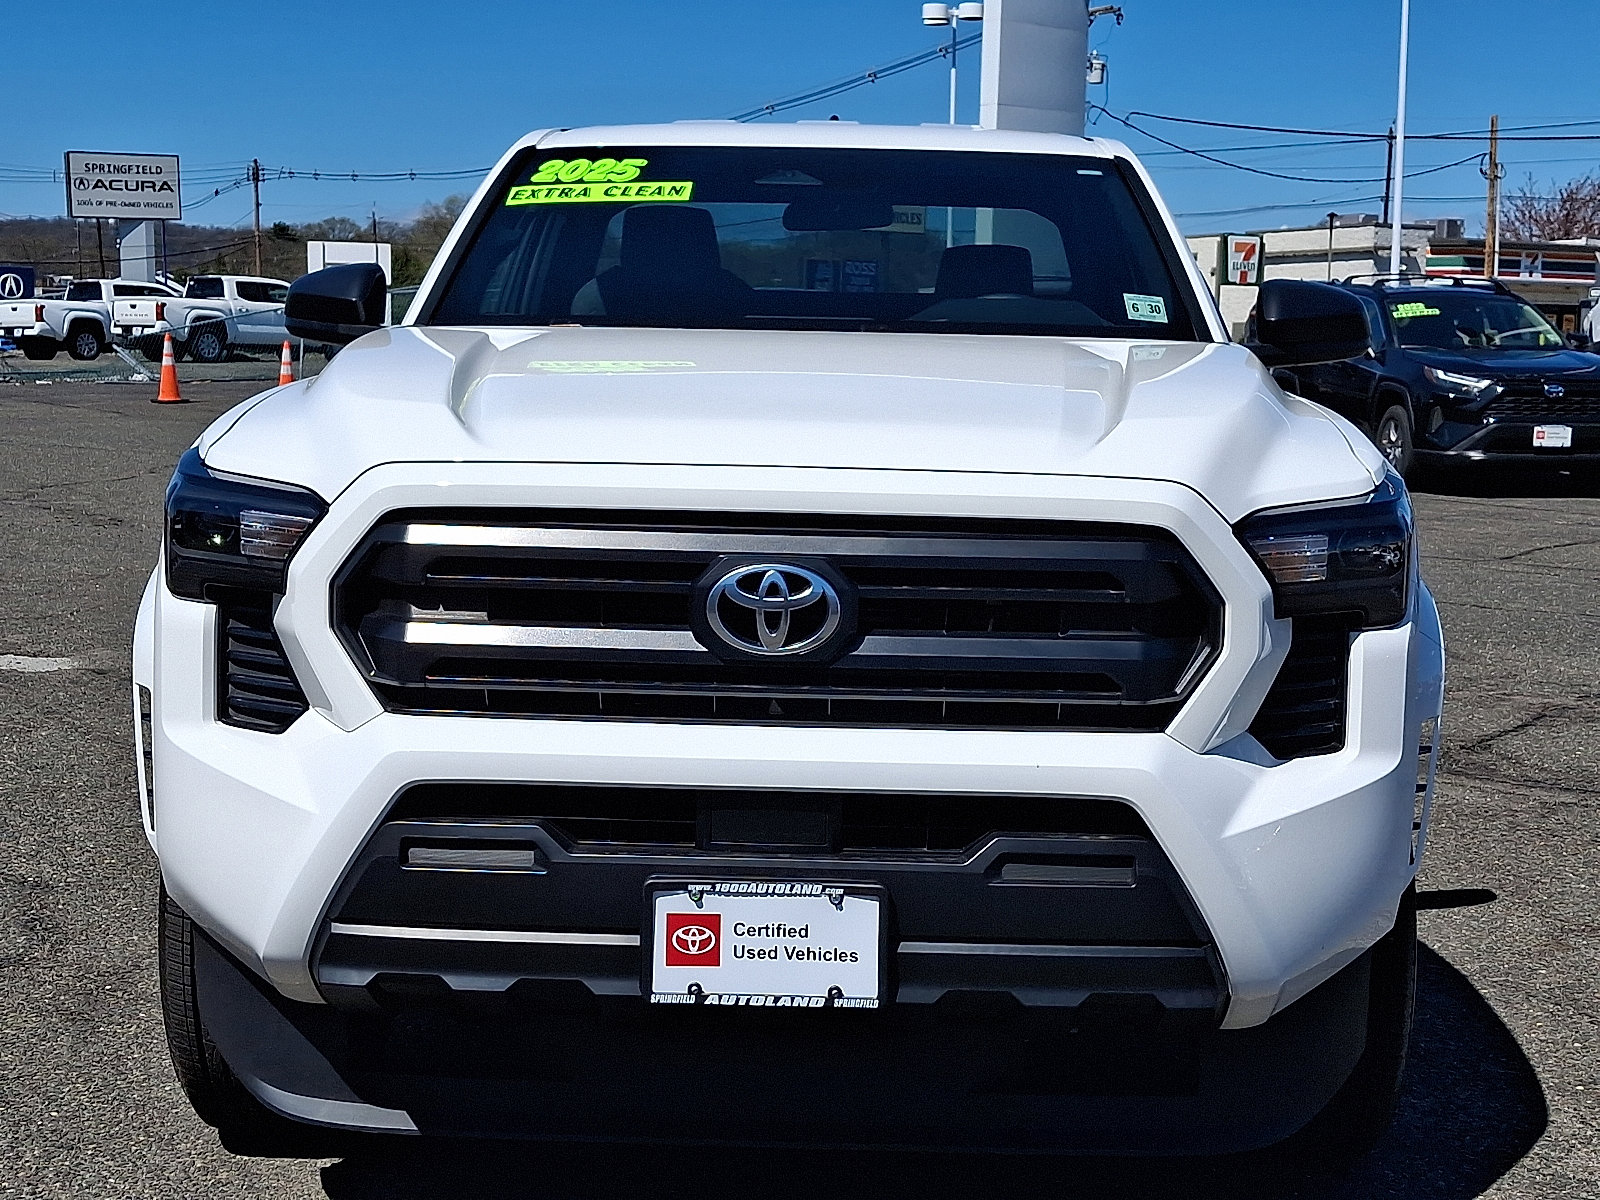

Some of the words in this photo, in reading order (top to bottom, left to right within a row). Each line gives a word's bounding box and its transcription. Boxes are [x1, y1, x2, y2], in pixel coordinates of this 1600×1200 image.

[85, 163, 162, 175] SPRINGFIELD
[531, 159, 648, 182] 2025
[92, 179, 174, 192] ACURA
[511, 187, 591, 201] EXTRA
[603, 185, 687, 198] CLEAN
[1235, 242, 1256, 284] 7
[1132, 303, 1139, 312] 6
[1147, 304, 1161, 314] 30
[733, 922, 809, 938] Certified
[733, 944, 778, 960] Used
[784, 946, 859, 962] Vehicles
[651, 994, 696, 1004] SPRINGFIELD
[704, 995, 825, 1008] AUTOLAND
[833, 998, 879, 1009] SPRINGFIELD
